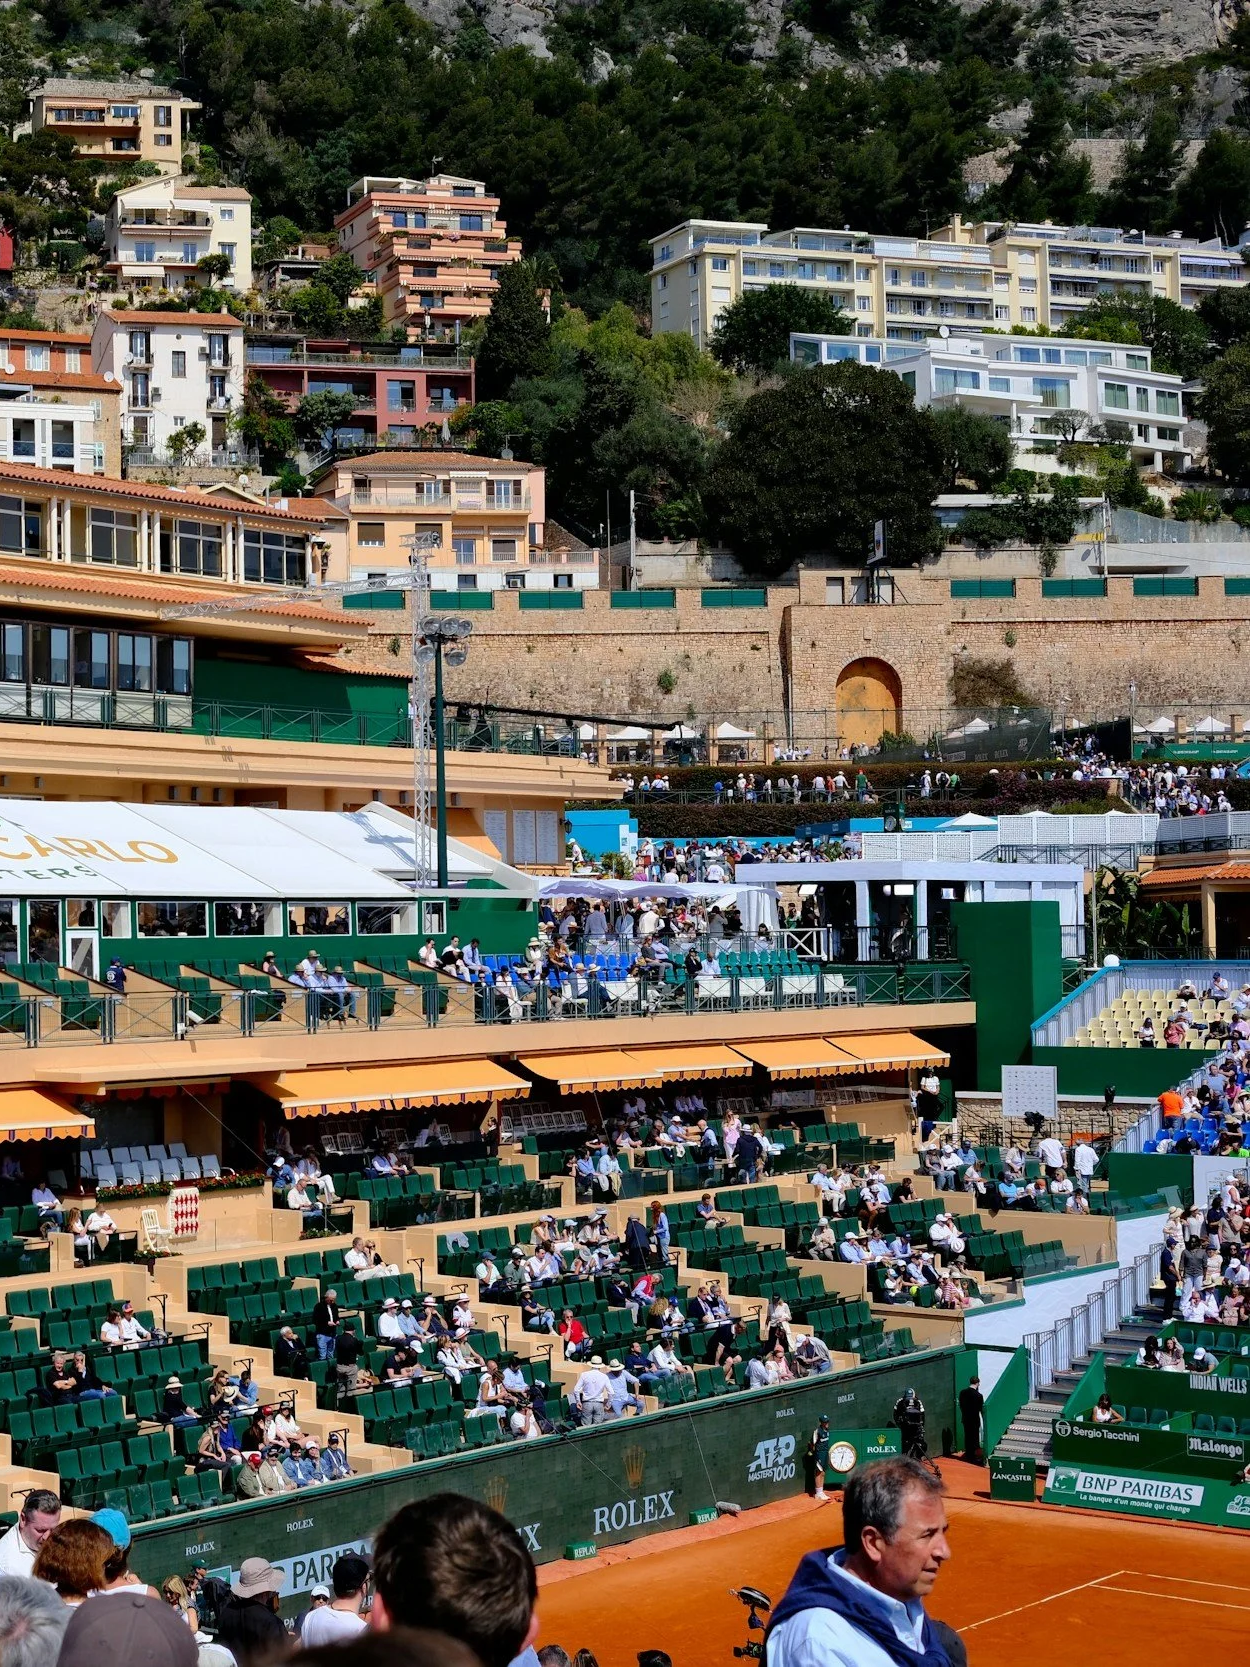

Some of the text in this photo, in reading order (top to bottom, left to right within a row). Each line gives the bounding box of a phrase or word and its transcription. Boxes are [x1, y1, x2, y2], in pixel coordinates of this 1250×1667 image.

[1189, 1374, 1248, 1395] INDIAN WELLS
[837, 1393, 855, 1404] ROLEX
[775, 1407, 795, 1419] ROLEX
[1072, 1426, 1140, 1443] Sergio Tacchini
[746, 1434, 796, 1473] ATP
[867, 1446, 897, 1454] ROLEX
[1188, 1437, 1244, 1458] Malongo
[747, 1462, 796, 1483] MASTERS 1000
[998, 1461, 1003, 1469] 1
[992, 1472, 1032, 1482] LANCASTER
[1082, 1475, 1194, 1502] BNP PARIBAS
[1079, 1493, 1191, 1514] La banque d'un monde qui change
[593, 1490, 676, 1536] ROLEX
[697, 1511, 718, 1524] REPLAY
[286, 1518, 314, 1533] ROLEX
[185, 1541, 215, 1556] ROLEX
[574, 1544, 597, 1559] REPLAY
